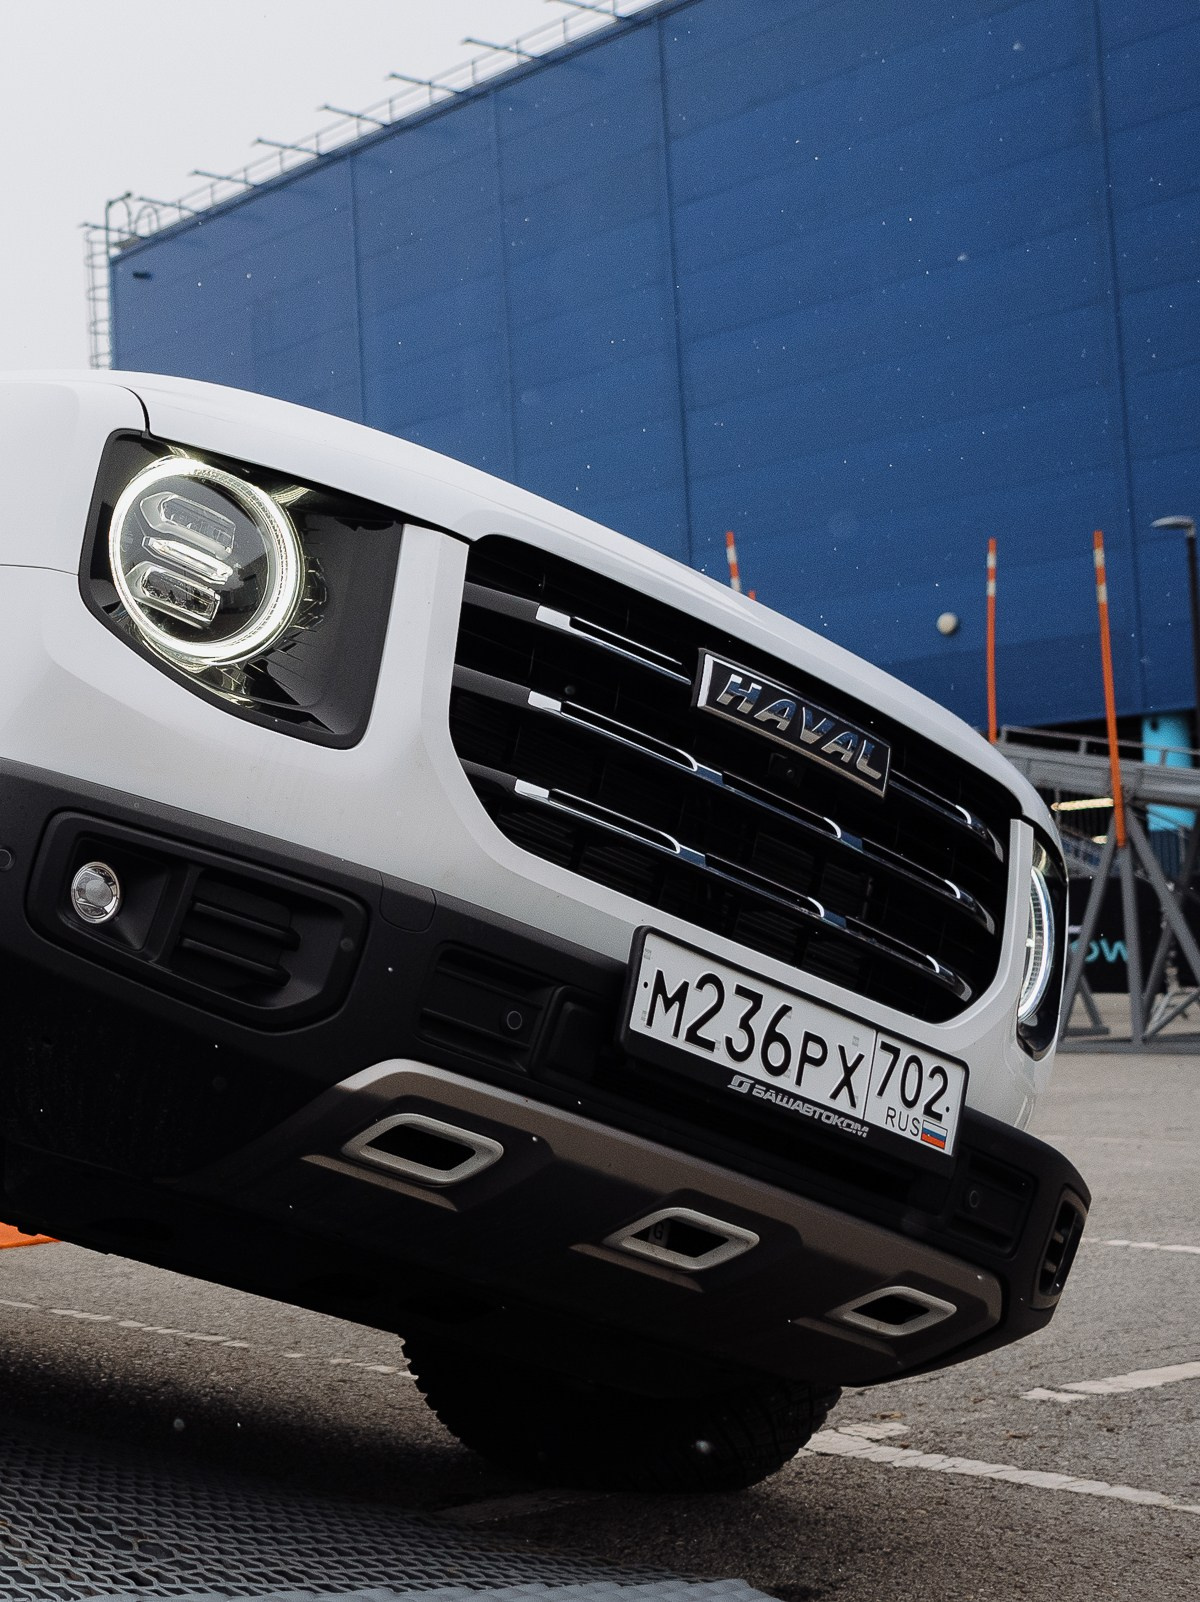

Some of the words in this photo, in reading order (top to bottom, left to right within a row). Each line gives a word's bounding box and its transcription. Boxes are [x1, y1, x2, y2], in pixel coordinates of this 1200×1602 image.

[716, 674, 882, 780] HAVAL
[752, 1085, 869, 1138] БАШАВТОКОМ
[876, 1040, 949, 1122] 702
[885, 1106, 920, 1137] RUS
